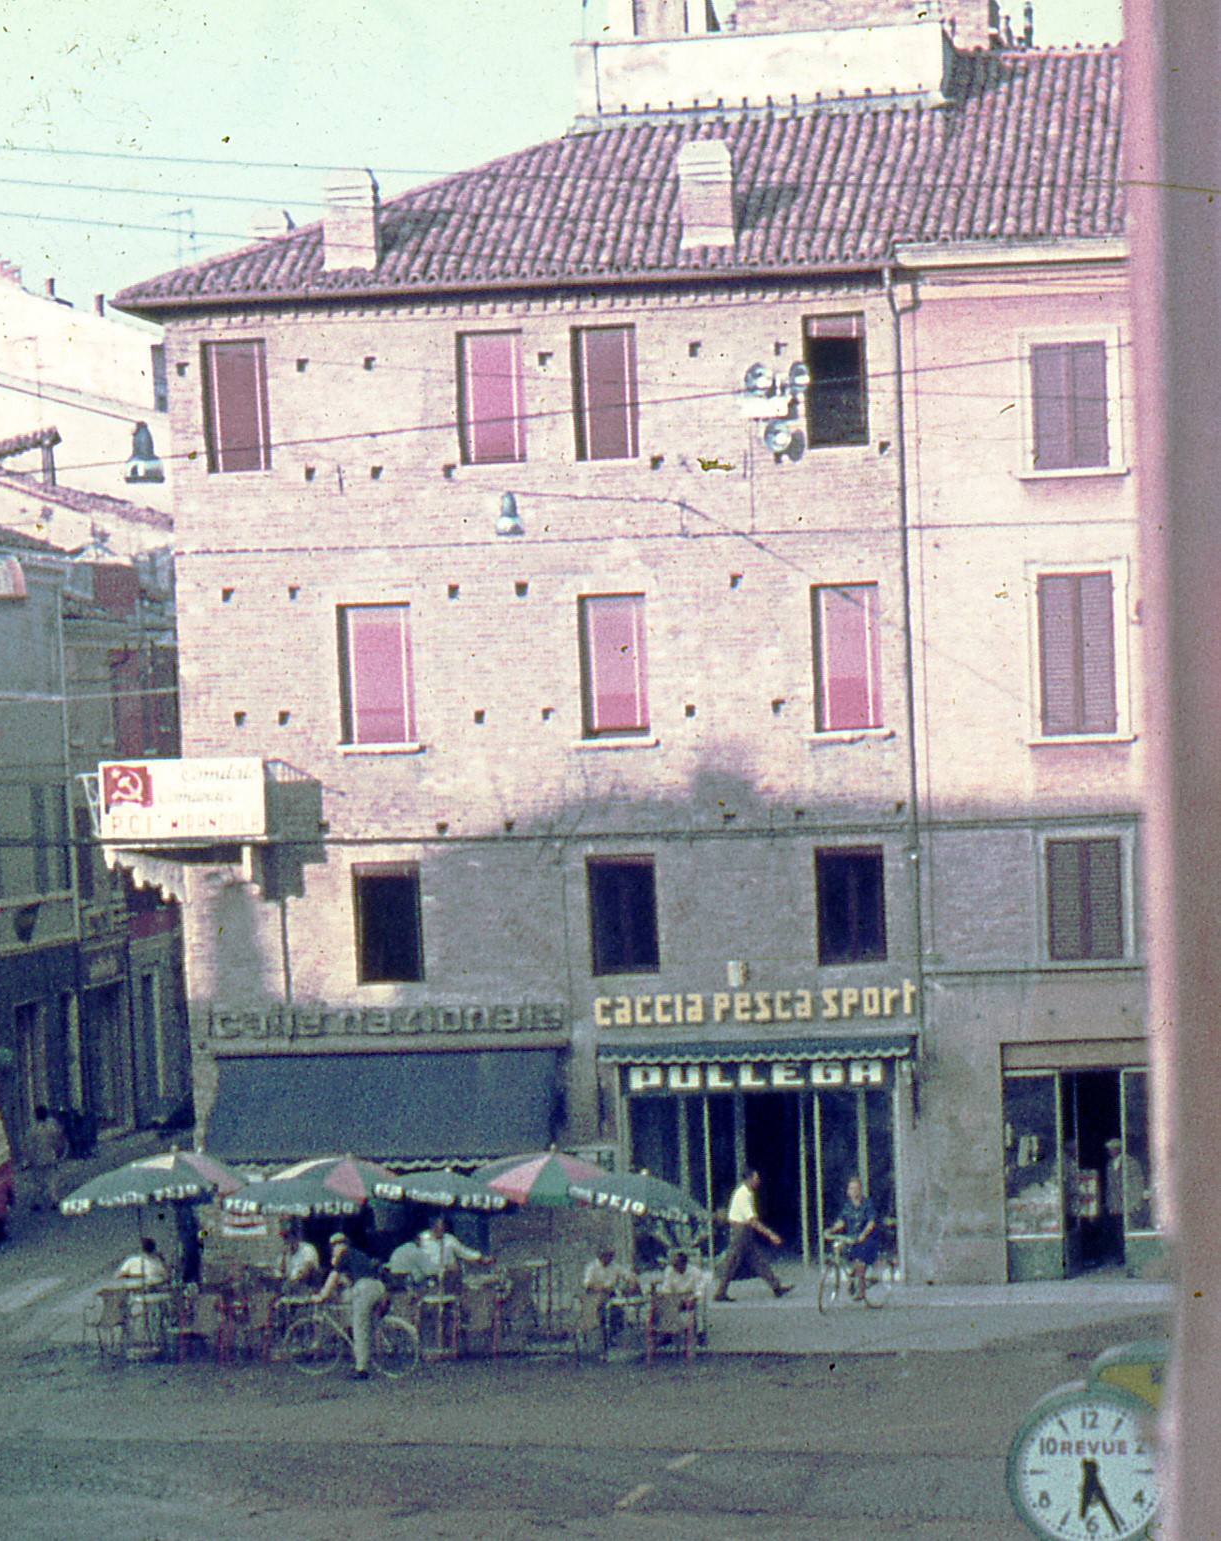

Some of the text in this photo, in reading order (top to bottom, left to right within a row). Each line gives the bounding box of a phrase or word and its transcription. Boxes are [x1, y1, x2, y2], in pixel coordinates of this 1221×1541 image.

[629, 1060, 884, 1091] PULLEGA
[314, 1200, 356, 1216] PEJO
[595, 1191, 647, 1216] PEJO
[1080, 1410, 1099, 1430] 12
[1039, 1439, 1058, 1456] 10
[1060, 1440, 1128, 1455] REVUE
[1038, 1490, 1052, 1507] 8
[1132, 1489, 1146, 1505] 4
[1085, 1515, 1100, 1533] 6
